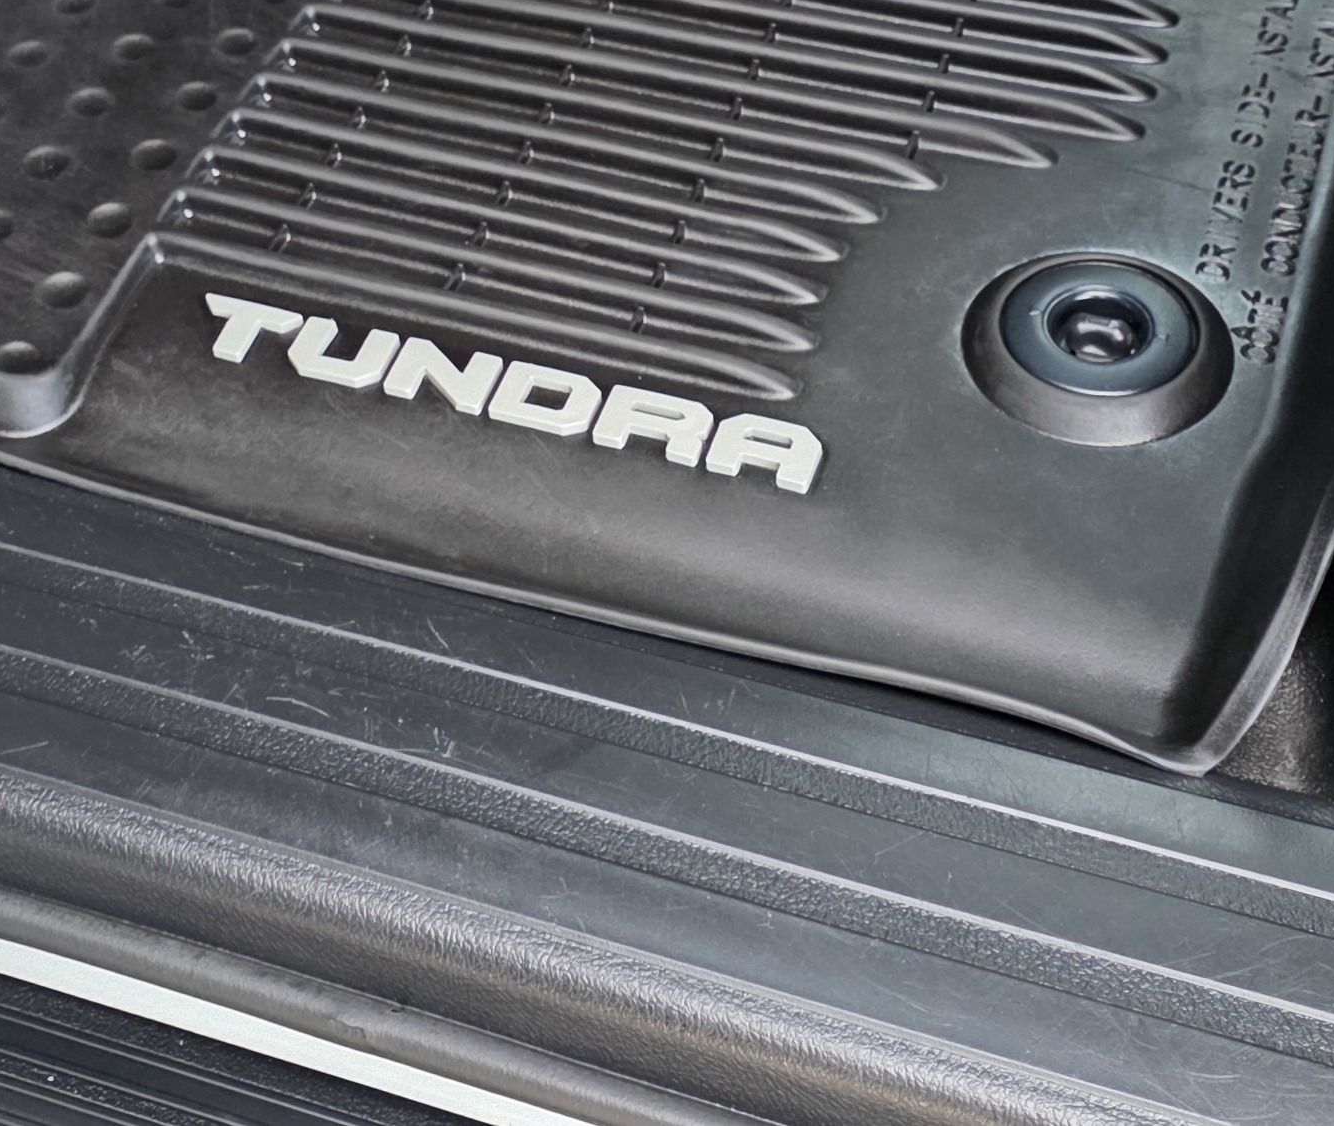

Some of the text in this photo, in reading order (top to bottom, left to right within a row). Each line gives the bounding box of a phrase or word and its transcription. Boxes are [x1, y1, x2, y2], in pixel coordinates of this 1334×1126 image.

[1194, 159, 1256, 282] DRIVERS
[1230, 288, 1290, 365] CÔTÉ
[204, 291, 823, 495] TUNDRA
